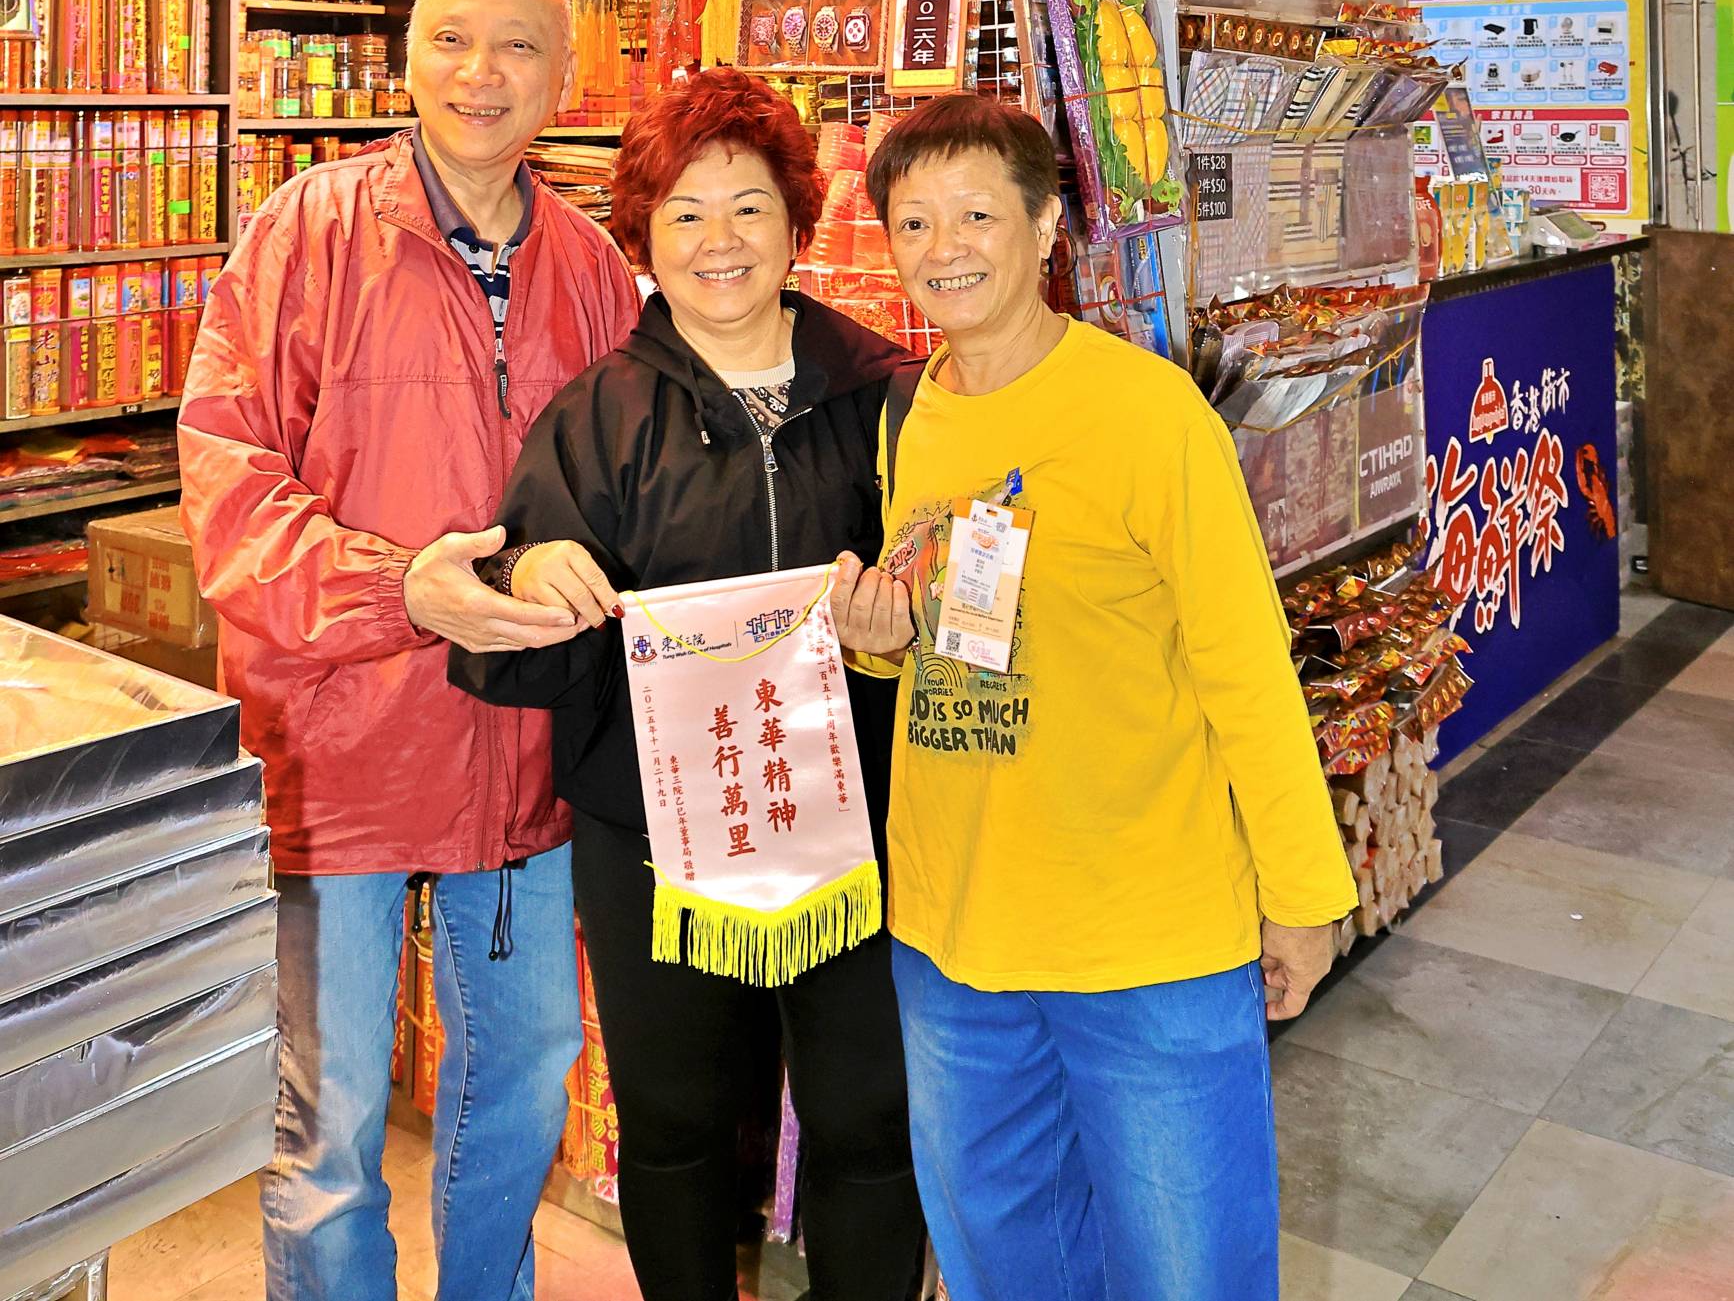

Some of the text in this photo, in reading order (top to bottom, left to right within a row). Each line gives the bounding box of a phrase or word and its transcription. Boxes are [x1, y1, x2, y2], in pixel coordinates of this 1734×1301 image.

[1196, 154, 1227, 171] 1件$28
[1197, 177, 1227, 194] 2件$50
[1197, 200, 1227, 217] 5件$100
[1510, 367, 1571, 435] 香港街市
[1419, 427, 1568, 634] 海鮮祭
[926, 677, 945, 687] YOUR
[980, 679, 1008, 692] REGRETS
[952, 699, 973, 720] SO
[978, 697, 1029, 728] MUCH
[753, 678, 797, 833] 東華精神
[970, 726, 1016, 756] THAN
[707, 703, 757, 858] 善行萬里
